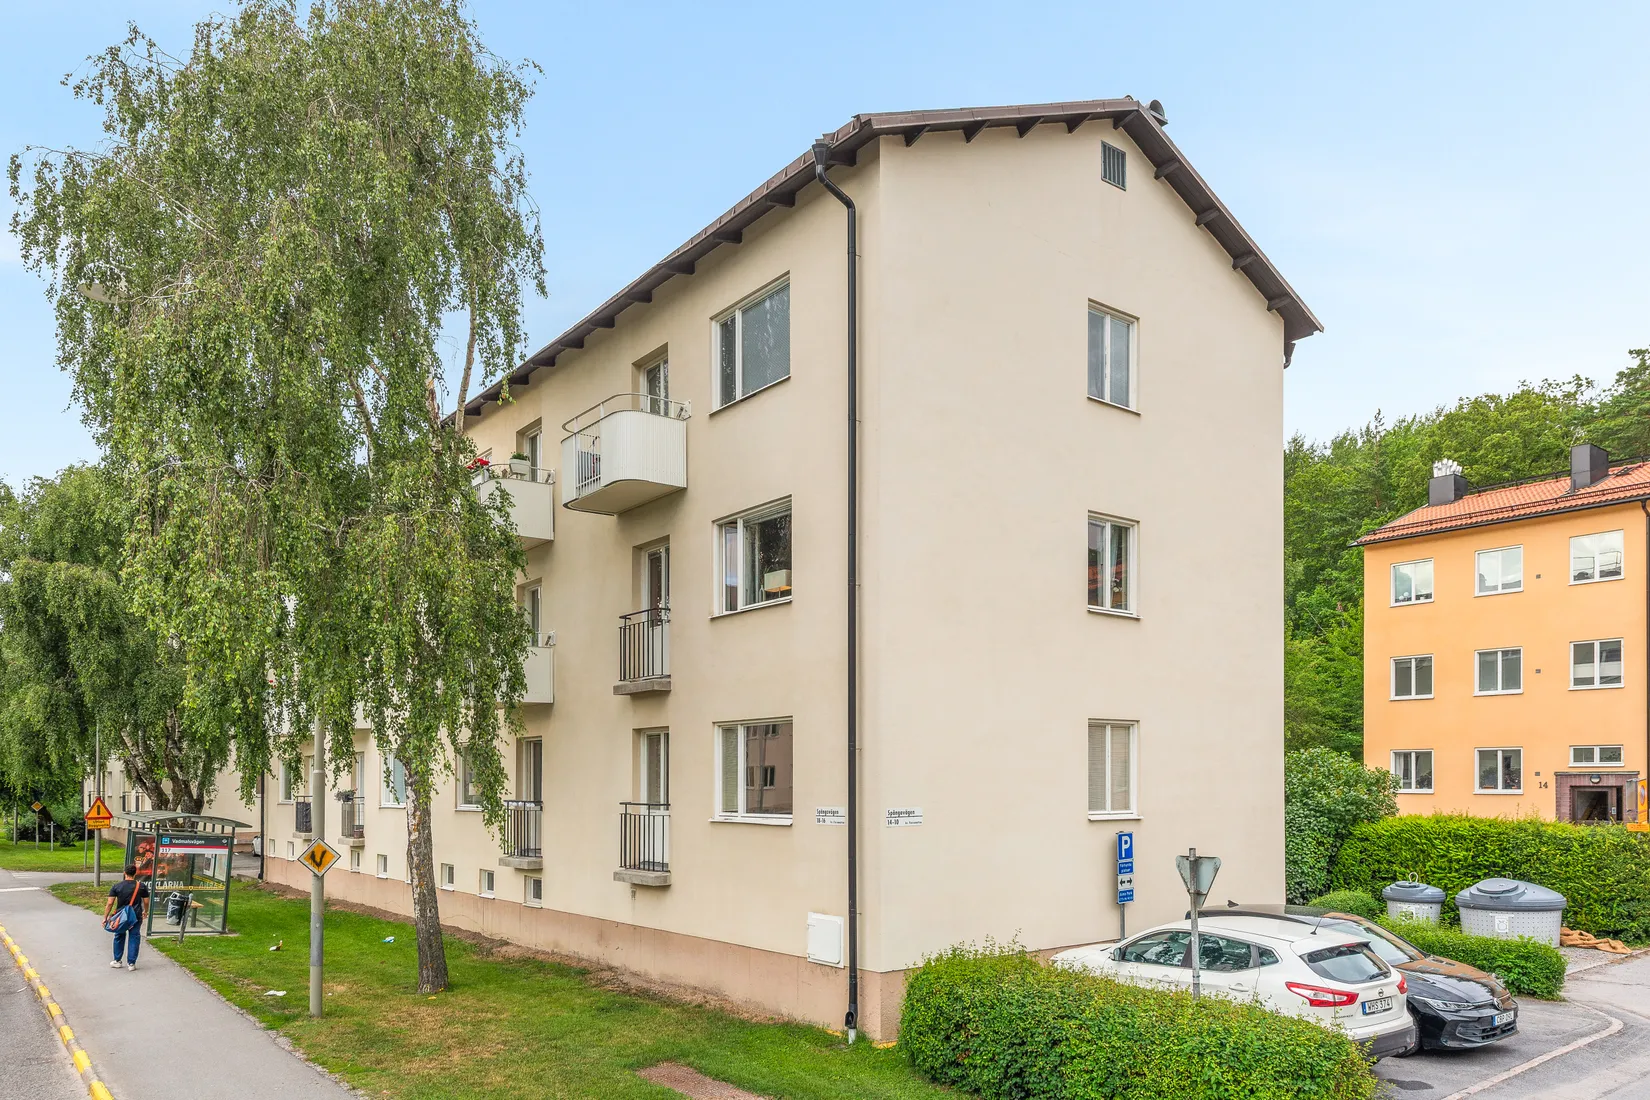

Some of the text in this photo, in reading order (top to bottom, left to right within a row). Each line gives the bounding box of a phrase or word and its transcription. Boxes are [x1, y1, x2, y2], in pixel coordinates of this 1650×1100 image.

[1539, 781, 1548, 789] 14
[1122, 836, 1130, 858] P
[1367, 998, 1390, 1011] WHS 374
